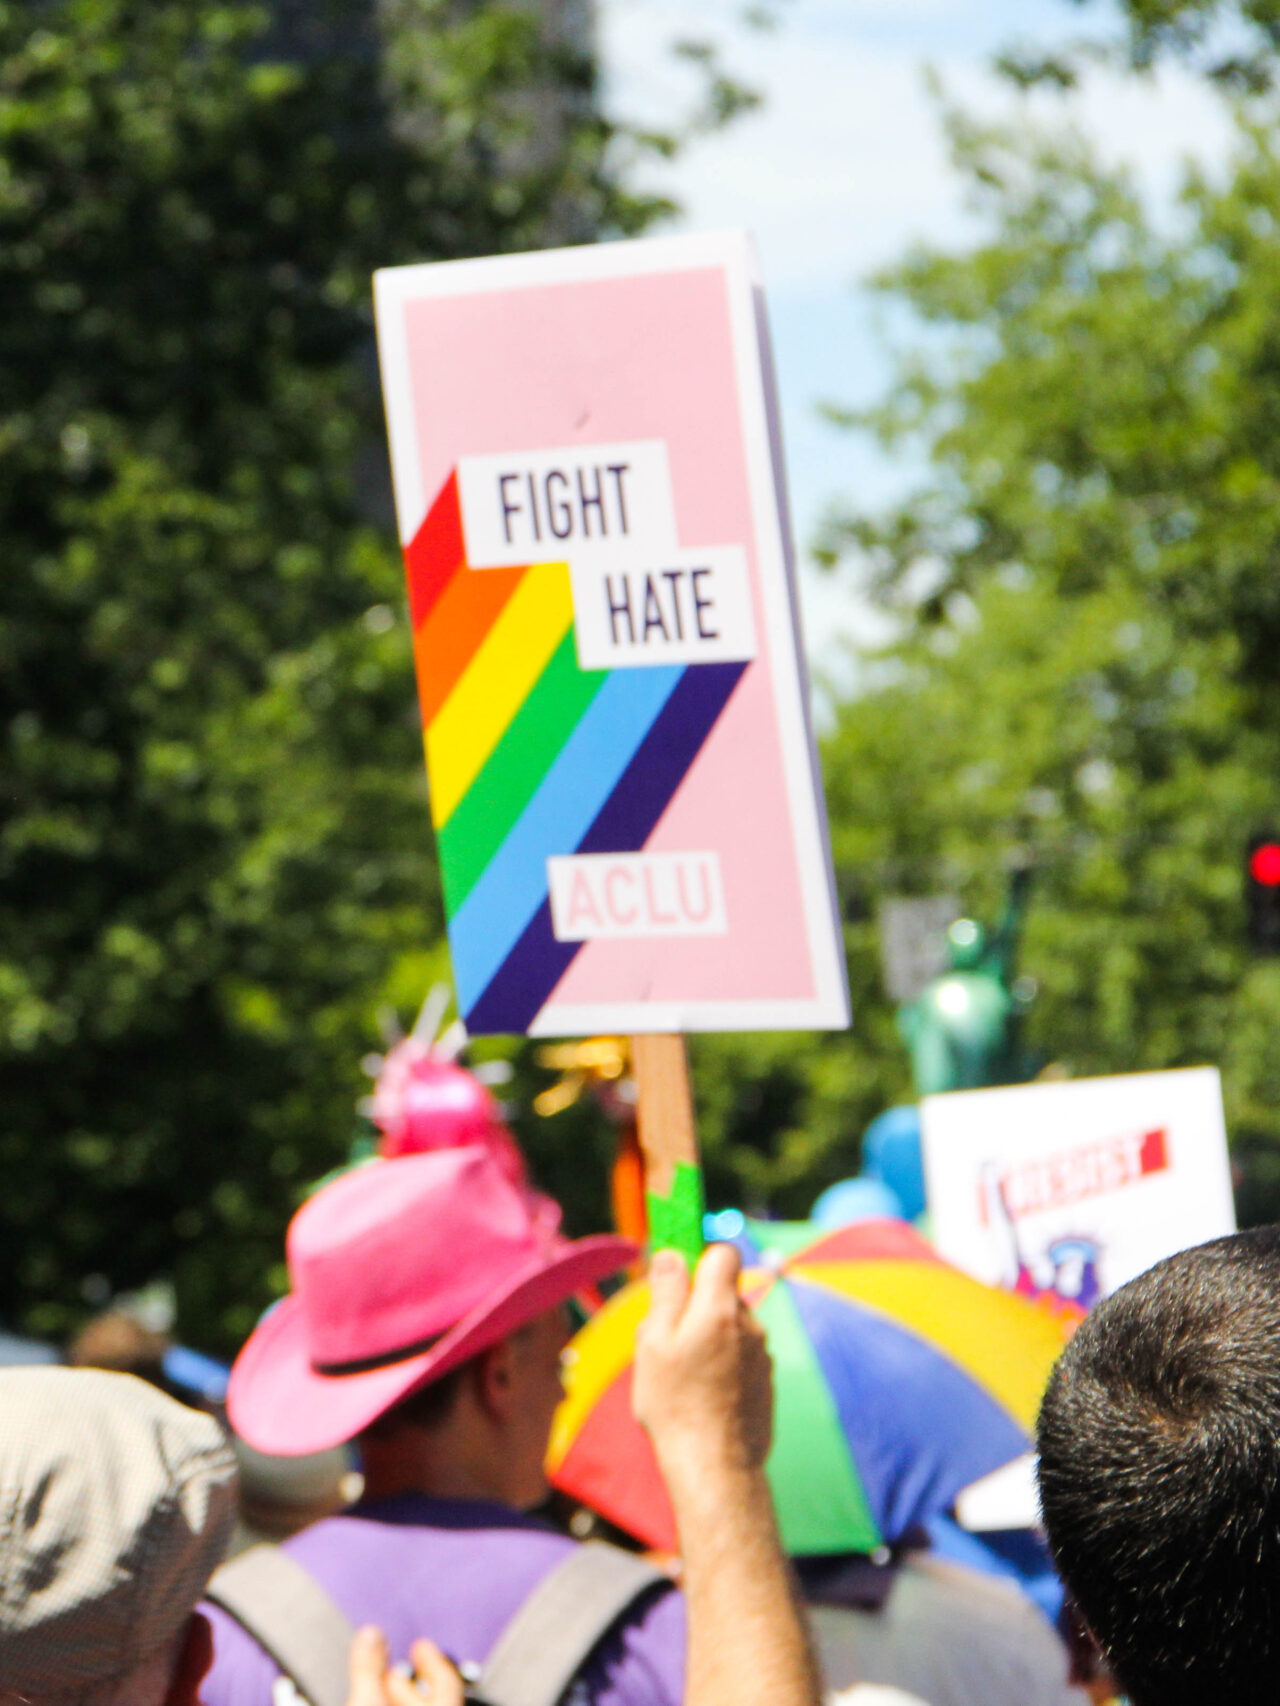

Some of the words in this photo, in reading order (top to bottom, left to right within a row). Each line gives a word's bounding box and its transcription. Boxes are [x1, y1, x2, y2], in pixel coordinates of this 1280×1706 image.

[498, 464, 630, 545] FIGHT
[604, 568, 719, 646] HATE
[566, 860, 713, 930] ACLU
